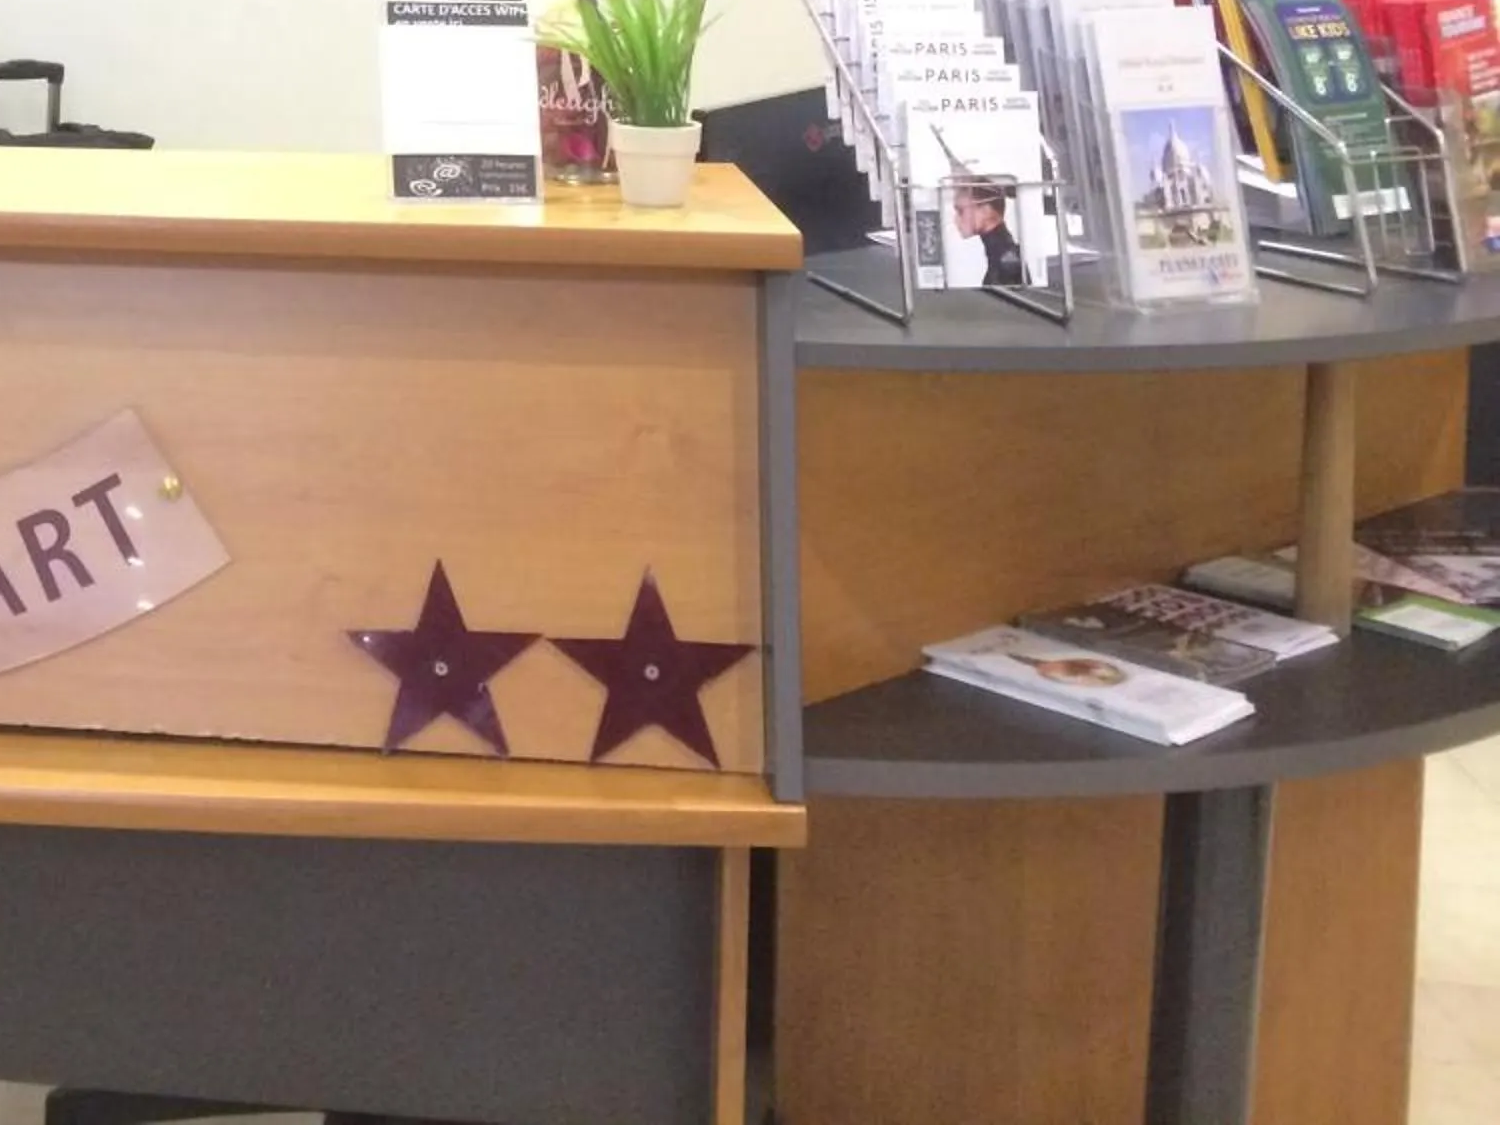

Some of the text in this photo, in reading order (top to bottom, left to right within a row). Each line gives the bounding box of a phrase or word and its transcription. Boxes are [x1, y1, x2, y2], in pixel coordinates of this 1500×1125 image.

[393, 4, 435, 16] CARTE
[438, 4, 492, 17] D'ACCES
[914, 42, 968, 56] PARIS
[925, 68, 981, 84] PARIS
[941, 97, 999, 113] PARIS
